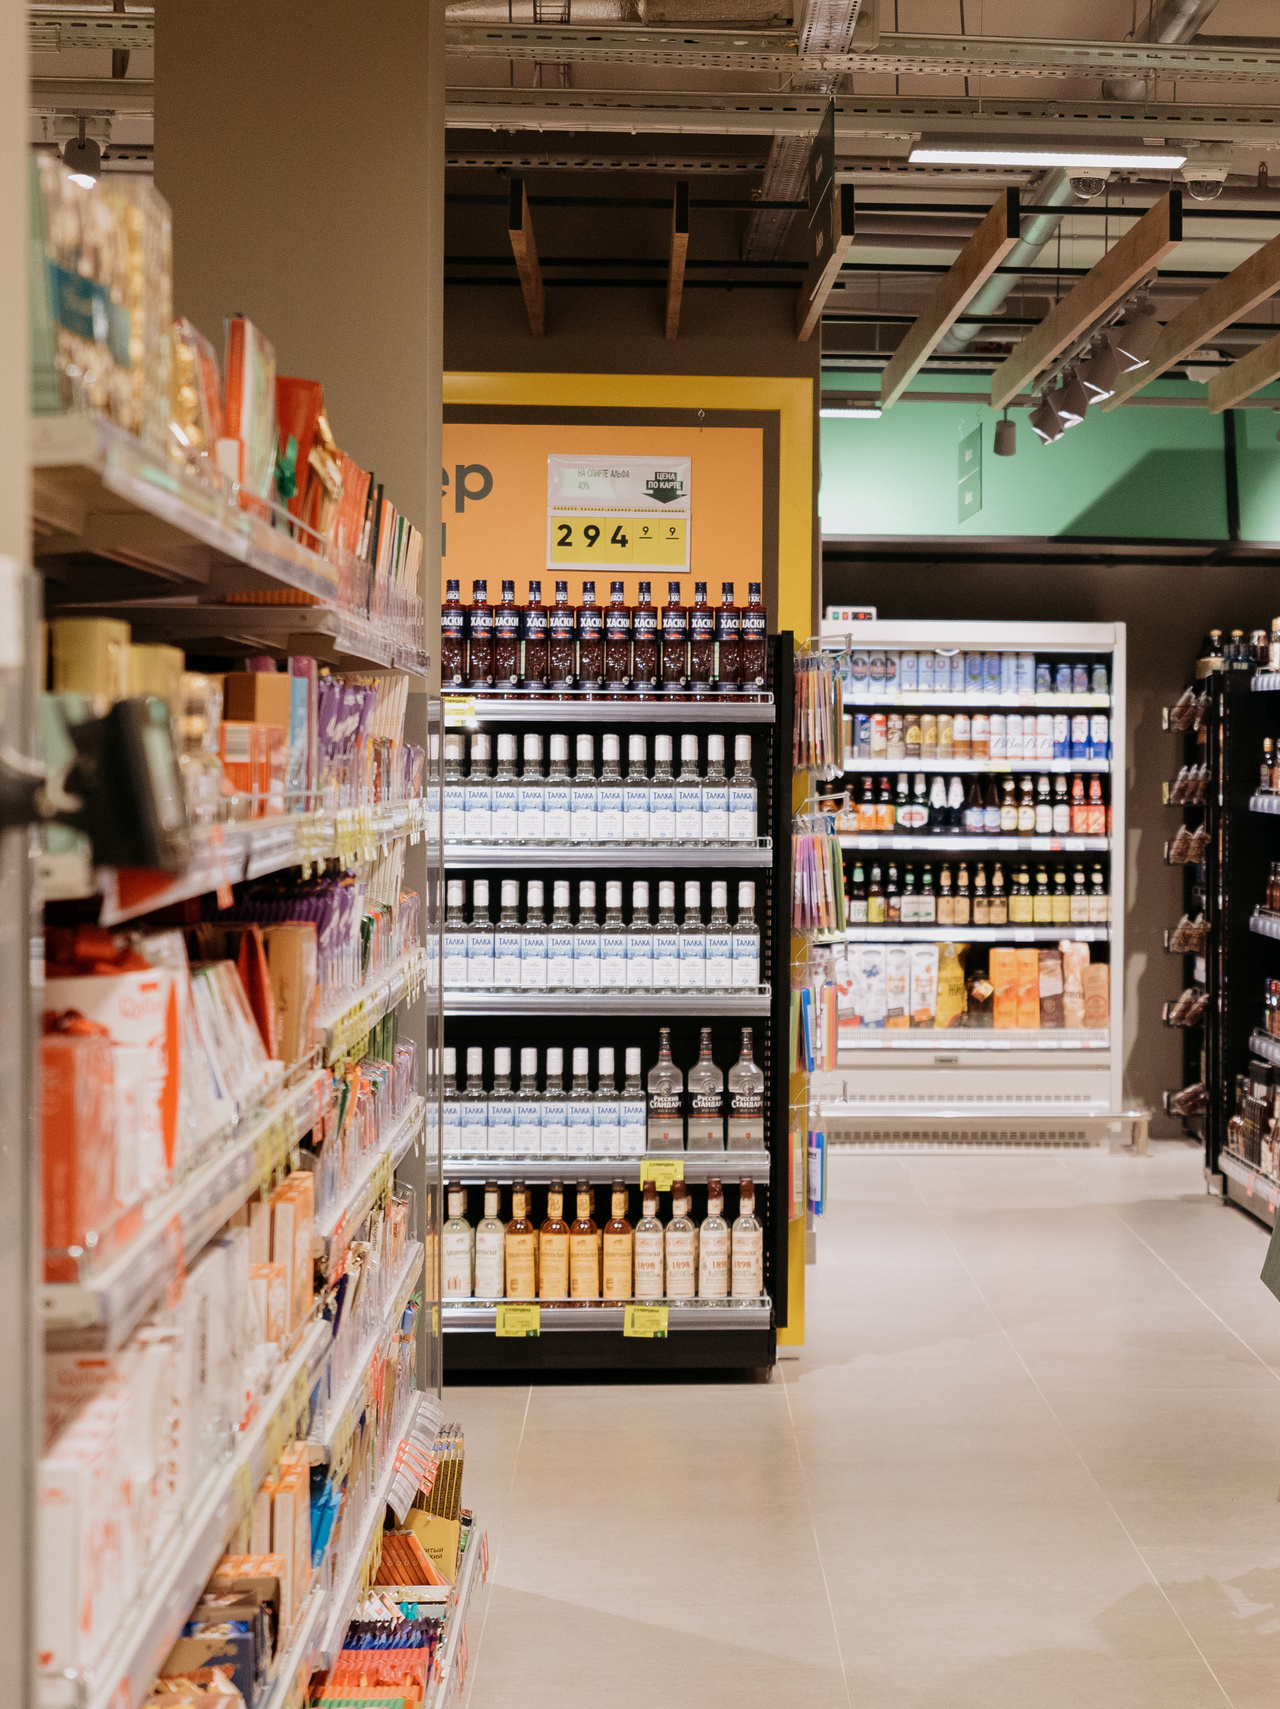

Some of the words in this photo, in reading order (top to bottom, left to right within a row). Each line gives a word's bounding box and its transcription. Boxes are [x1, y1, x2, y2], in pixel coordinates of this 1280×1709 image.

[577, 469, 587, 477] НА
[610, 470, 630, 478] АЛЬФА
[656, 472, 676, 480] ЦЕНА
[648, 481, 658, 489] ПО
[660, 482, 682, 490] КАРТЕ
[468, 791, 488, 799] ТАЛКА
[495, 791, 515, 799] ТАЛКА
[522, 791, 542, 799] ТАЛКА
[547, 791, 567, 799] ТАЛКА
[574, 791, 593, 799] ТАЛКА
[601, 791, 621, 800] ТАЛКА
[627, 791, 647, 800] ТАЛКА
[653, 791, 673, 800] ТАЛКА
[679, 791, 699, 800] ТАЛКА
[706, 791, 726, 800] ТАЛКА
[732, 791, 752, 800] ТАЛКА
[445, 938, 465, 946] ТАЛКА
[472, 938, 492, 946] ТАЛКА
[499, 938, 519, 946] ТАЛКА
[524, 939, 544, 947] ТАЛКА
[551, 939, 571, 947] ТАЛКА
[577, 939, 597, 947] ТАЛКА
[603, 939, 623, 947] ТАЛКА
[630, 939, 650, 947] ТАЛКА
[657, 939, 677, 947] ТАЛКА
[683, 939, 703, 947] ТАЛКА
[709, 939, 729, 947] ТАЛКА
[736, 939, 756, 947] ТАЛКА
[464, 1106, 484, 1114] ТАЛКА
[492, 1106, 512, 1114] ТАЛКА
[518, 1106, 537, 1114] ТАЛКА
[545, 1106, 564, 1114] ТАЛКА
[570, 1106, 590, 1114] ТАЛКА
[597, 1106, 617, 1114] ТАЛКА
[624, 1106, 644, 1114] ТАЛКА
[672, 1261, 691, 1269] 1898
